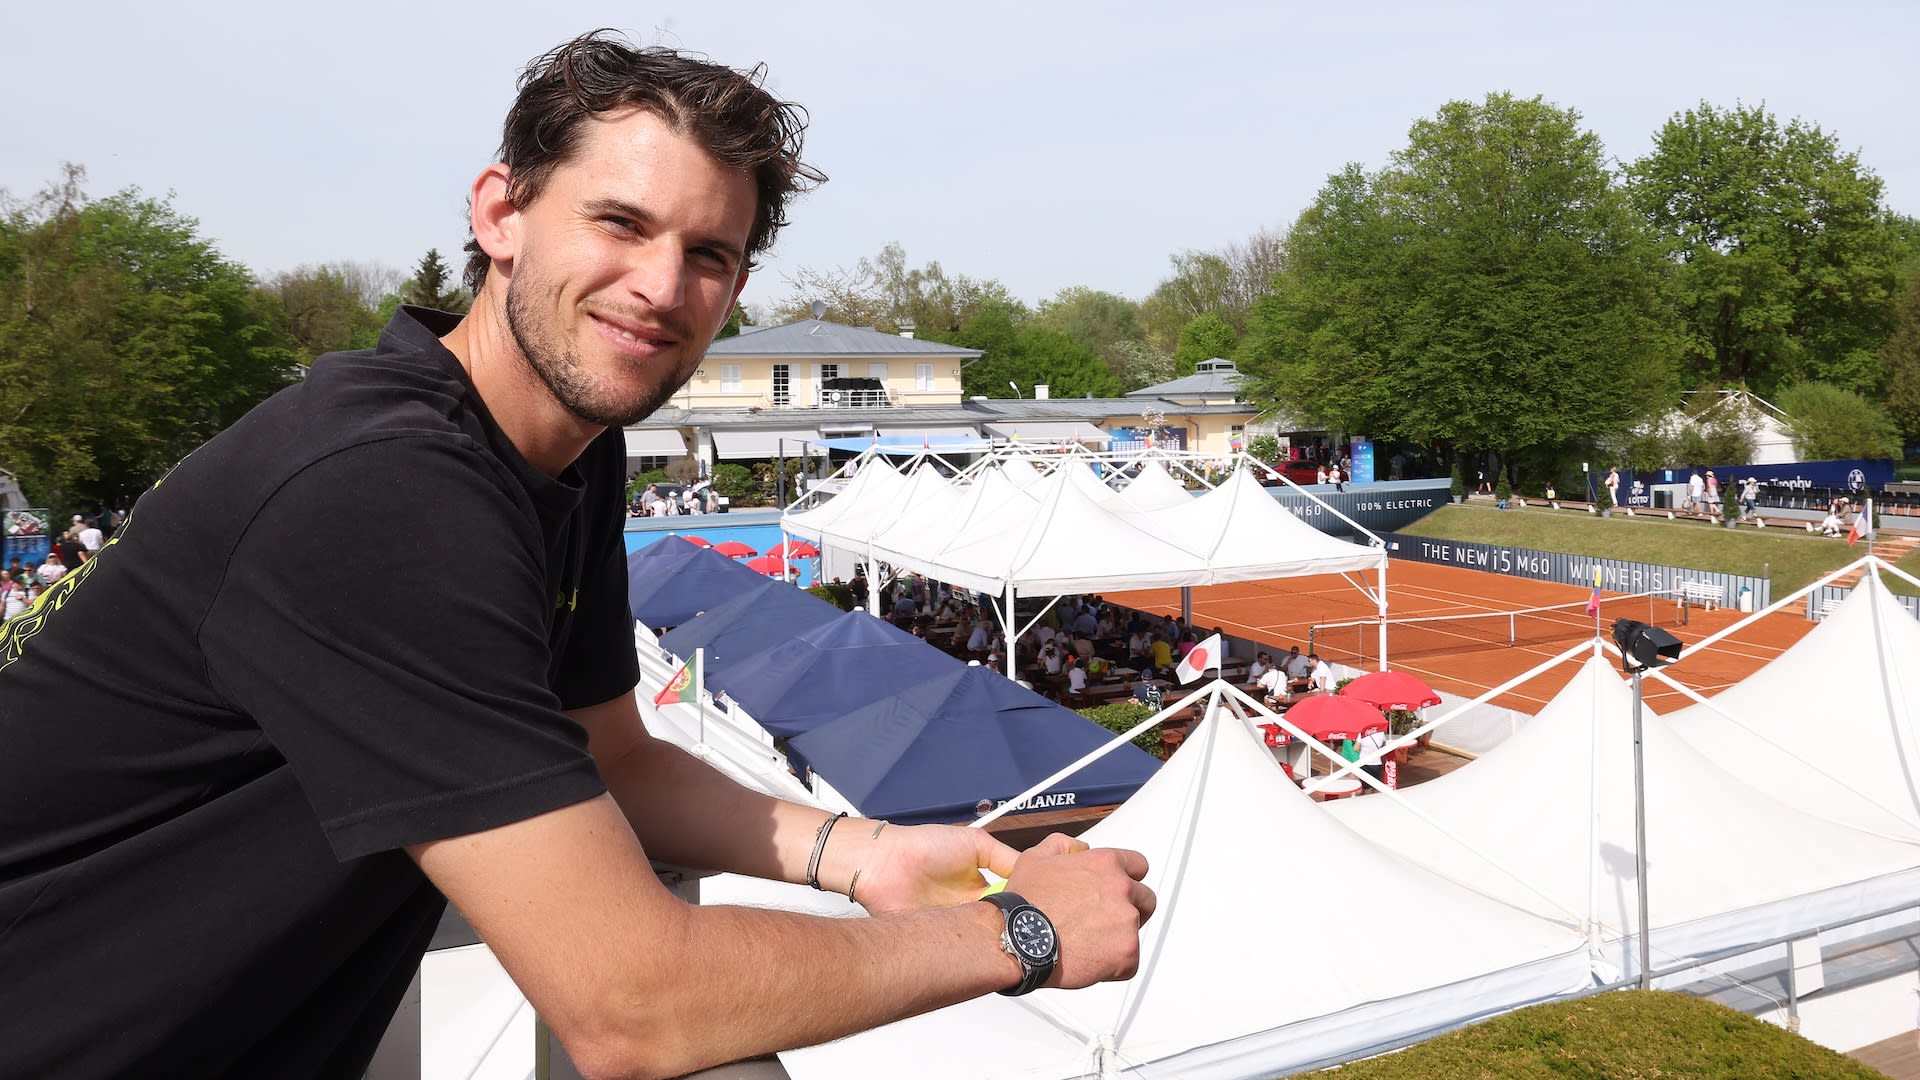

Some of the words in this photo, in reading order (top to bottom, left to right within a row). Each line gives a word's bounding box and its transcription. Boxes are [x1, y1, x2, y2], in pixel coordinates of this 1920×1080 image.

[1294, 504, 1321, 516] M60
[1356, 502, 1382, 511] 100%
[1386, 498, 1432, 510] ELECTRIC
[1422, 542, 1450, 561] THE
[1456, 547, 1488, 566] NEW
[1493, 547, 1511, 572] i5
[1517, 555, 1550, 575] M60
[997, 793, 1076, 811] PULANER
